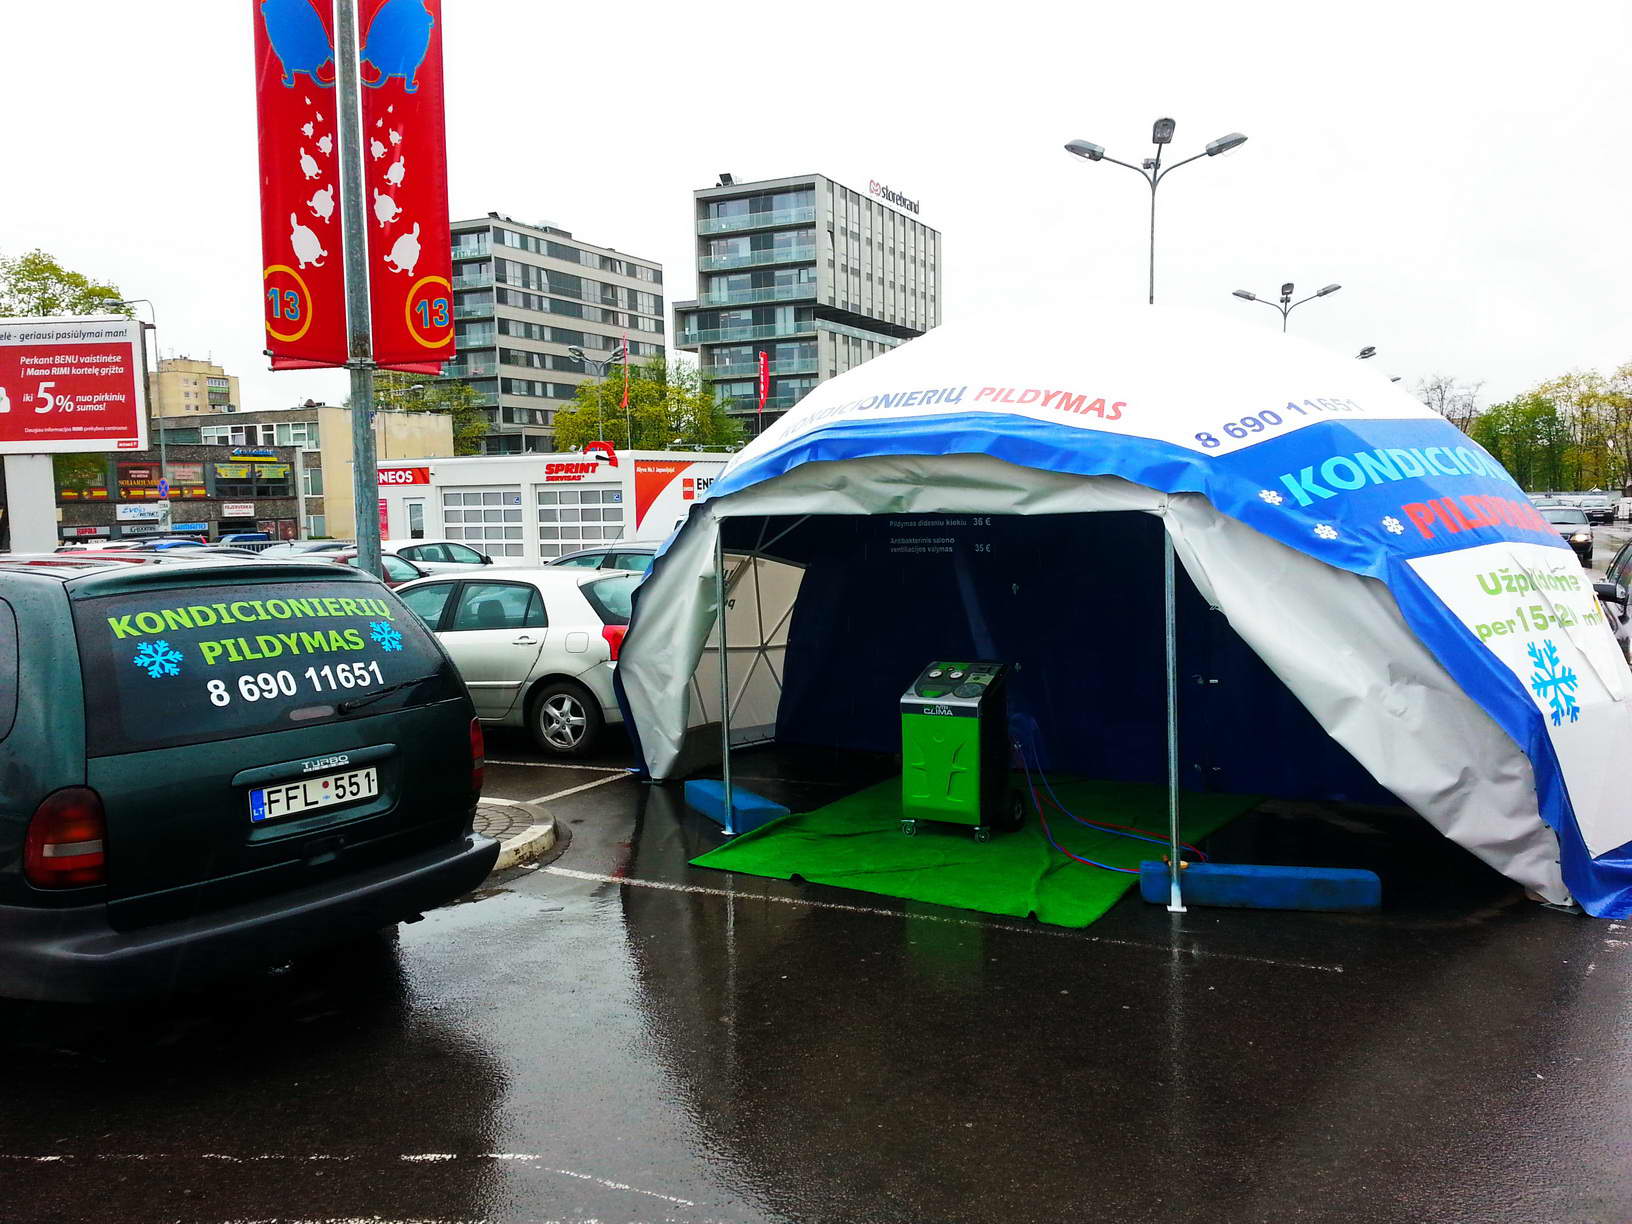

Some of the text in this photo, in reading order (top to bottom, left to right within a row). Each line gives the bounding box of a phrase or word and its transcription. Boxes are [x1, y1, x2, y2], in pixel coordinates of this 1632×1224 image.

[881, 185, 919, 215] storebrand
[267, 288, 300, 321] 13
[416, 298, 449, 329] 13
[19, 331, 54, 342] geriausi
[56, 329, 104, 341] pasiūlymai
[105, 328, 128, 337] man!
[20, 354, 122, 365] Perkant BENU vaistinėse
[26, 367, 51, 376] Mano
[51, 367, 71, 375] RIMI
[71, 366, 100, 376] kortelę
[22, 395, 34, 403] iki
[93, 393, 126, 403] pirkinių
[75, 403, 106, 411] sumos!
[974, 386, 1127, 421] PILDYMAS
[1195, 432, 1220, 448] 8
[1222, 409, 1285, 440] 690
[377, 470, 413, 483] NEOS
[545, 463, 600, 475] SPRINT
[107, 597, 395, 639] KONDICIONIERIŲ
[1475, 617, 1515, 643] per
[198, 629, 366, 665] PILDYMAS
[206, 660, 385, 707] 8 690 11651
[301, 754, 348, 769] TURBO
[252, 771, 373, 817] LT FFL 551
